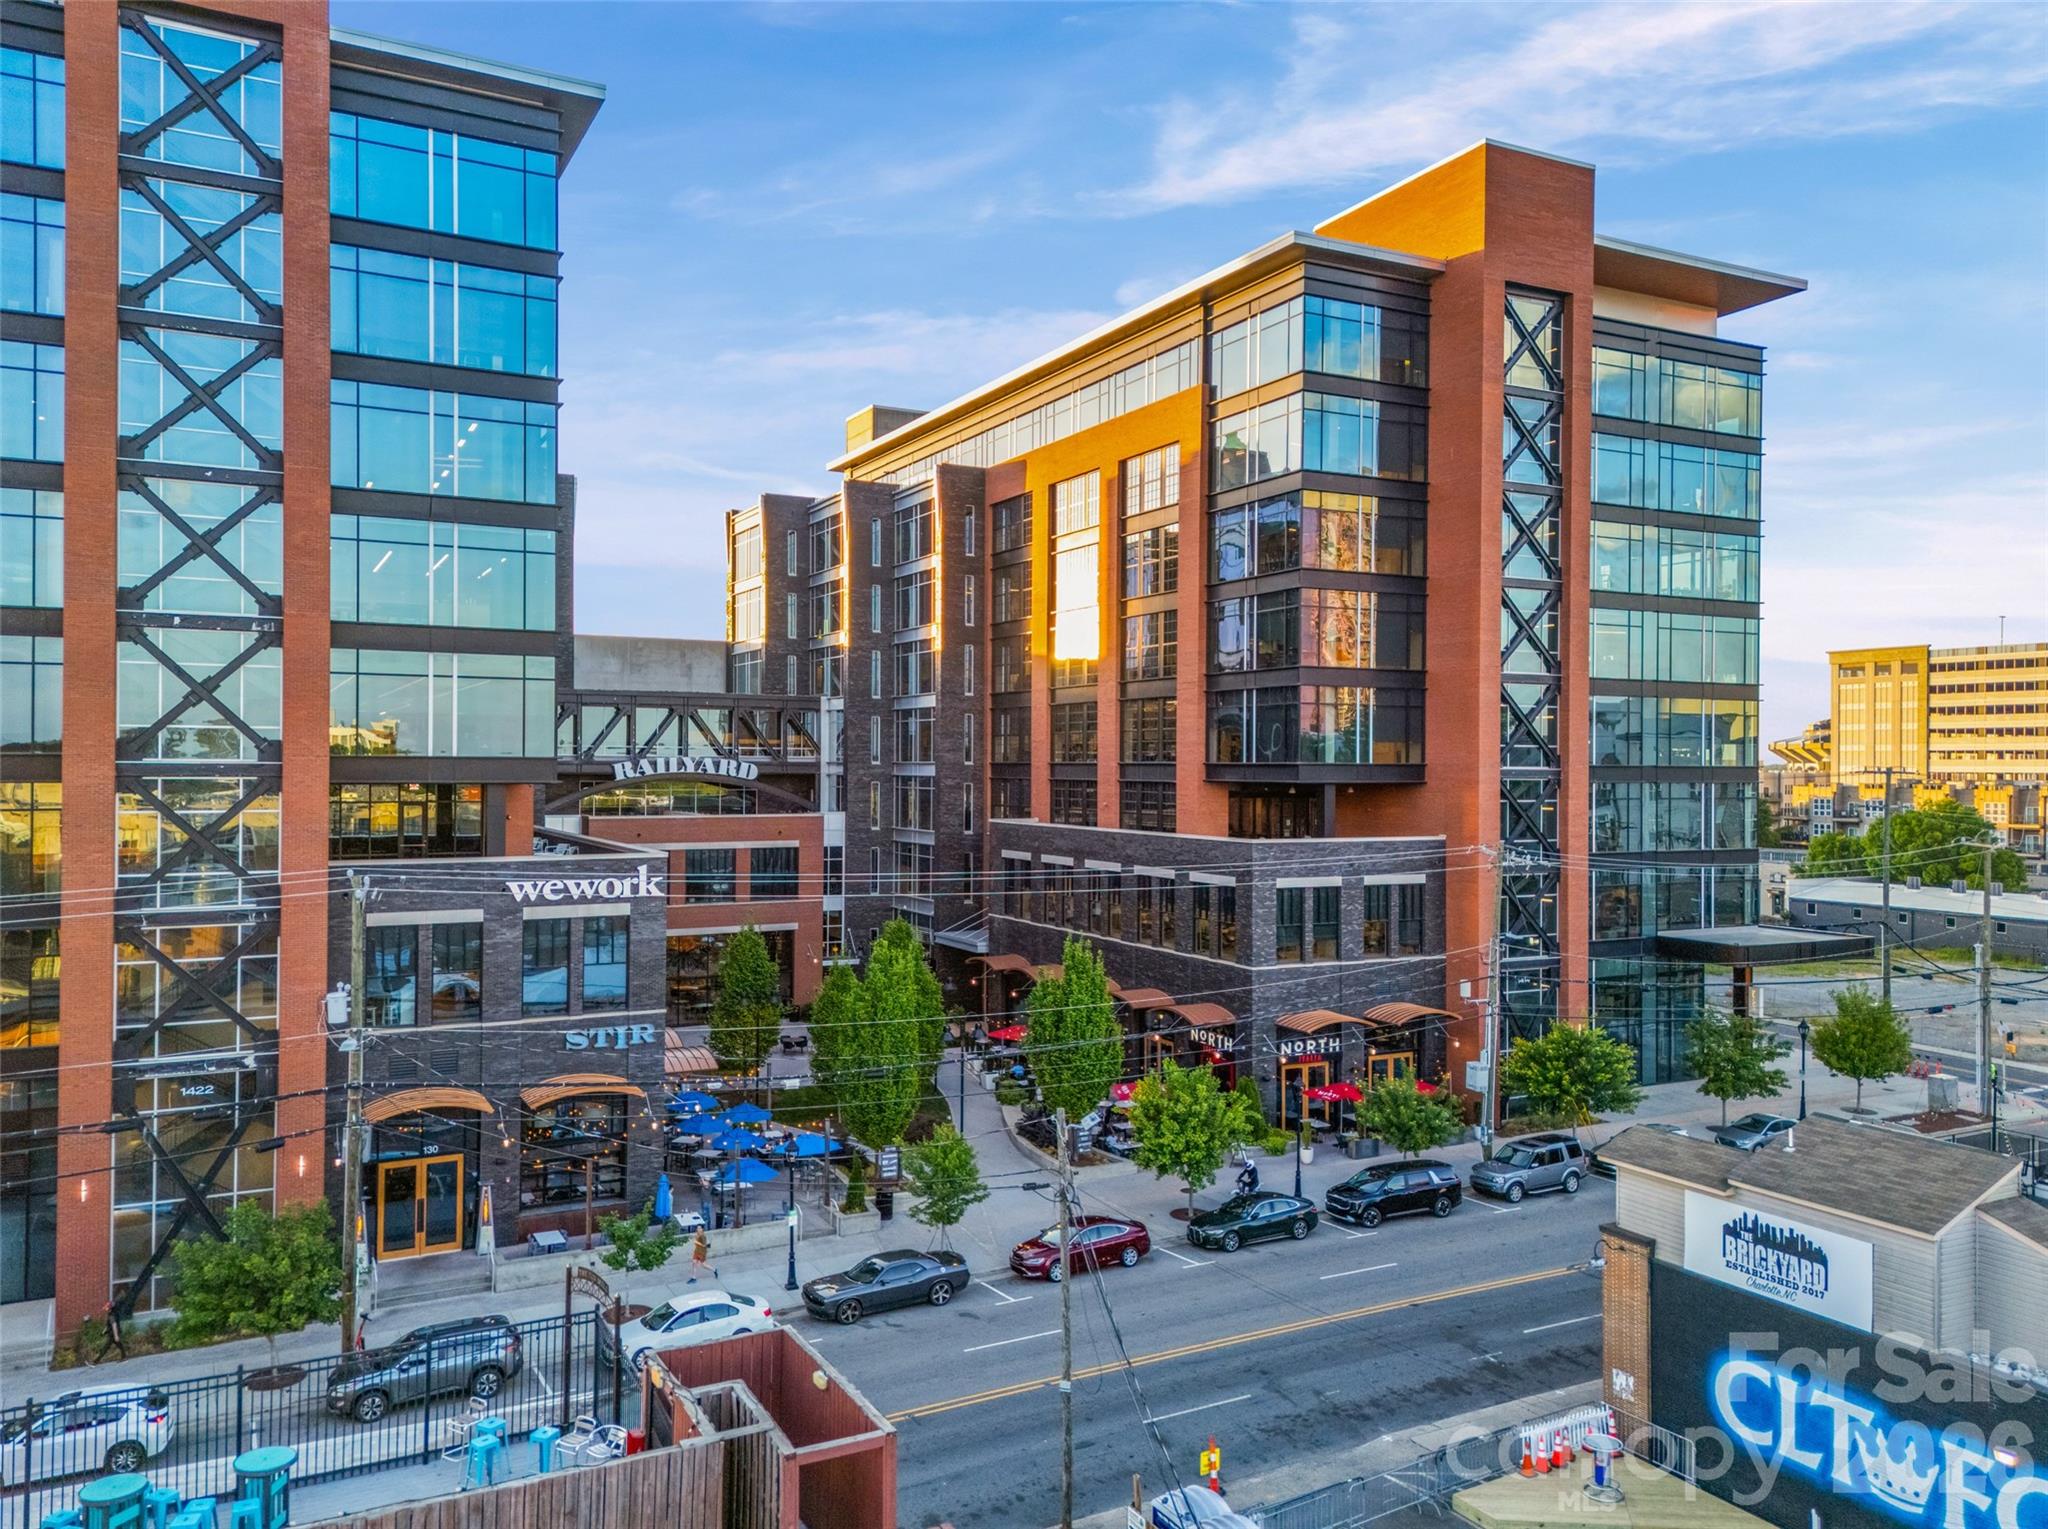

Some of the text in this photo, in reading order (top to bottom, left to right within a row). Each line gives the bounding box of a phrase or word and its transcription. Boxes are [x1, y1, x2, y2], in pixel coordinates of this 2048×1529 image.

[613, 757, 758, 781] RAILYARD
[506, 864, 665, 902] wework
[565, 1023, 656, 1050] STIR
[1191, 1029, 1233, 1052] NORTH
[1280, 1037, 1340, 1056] NORTH
[180, 1085, 214, 1096] 1422
[423, 1145, 439, 1154] 130
[1740, 1231, 1753, 1242] THE
[1725, 1234, 1826, 1291] BRICKYARD
[1725, 1259, 1825, 1300] ESTABLISHED 2017
[1714, 1360, 1875, 1486] CLT
